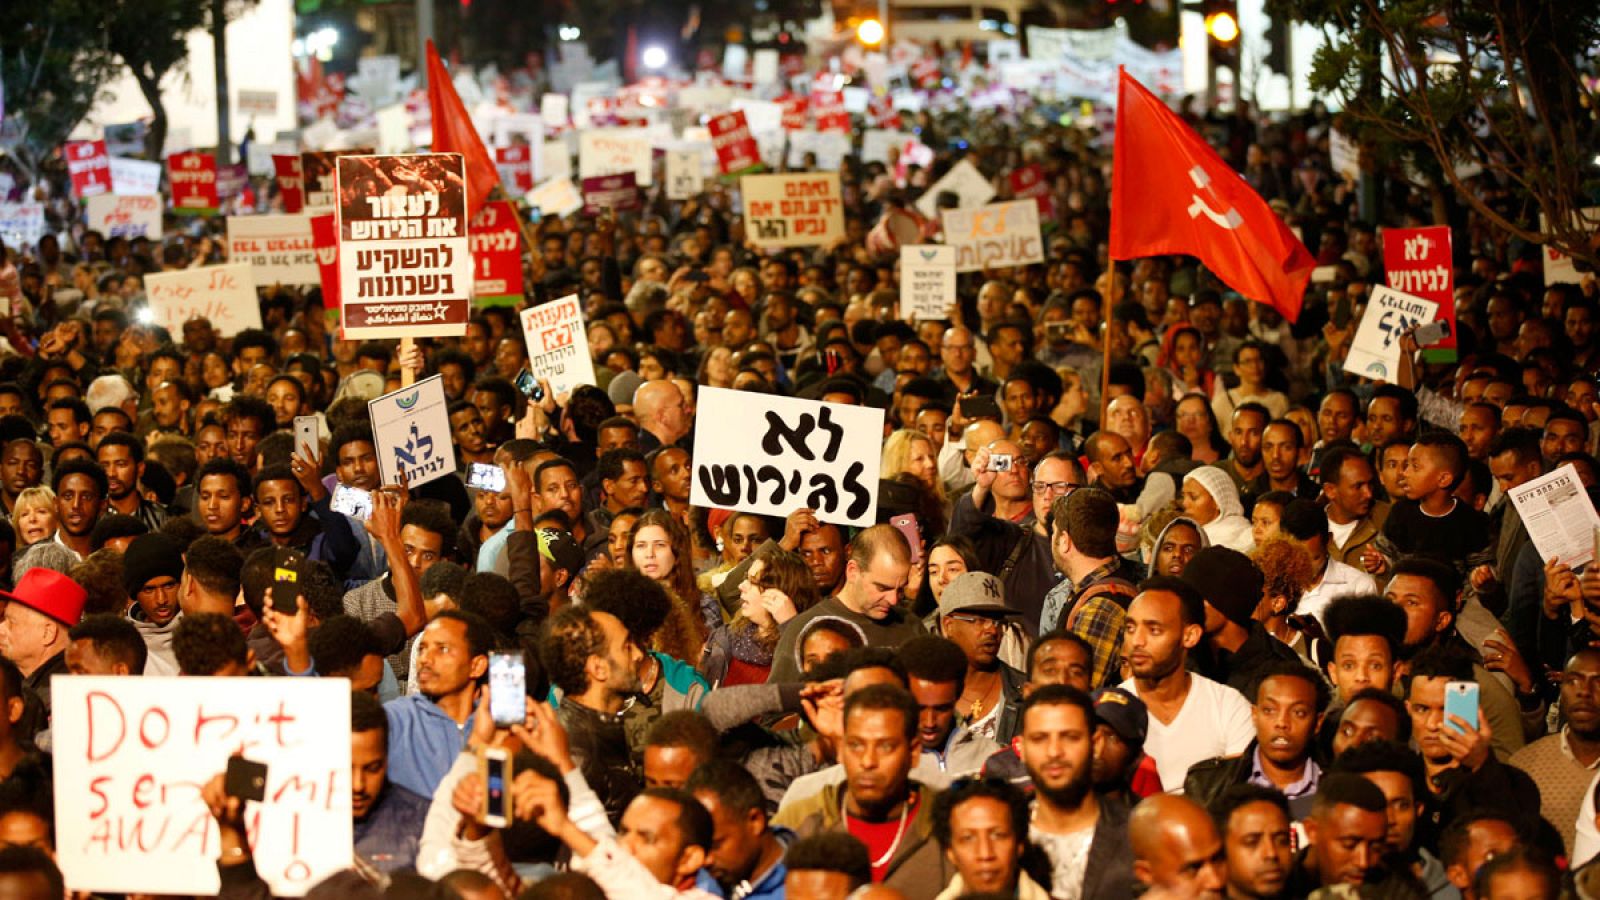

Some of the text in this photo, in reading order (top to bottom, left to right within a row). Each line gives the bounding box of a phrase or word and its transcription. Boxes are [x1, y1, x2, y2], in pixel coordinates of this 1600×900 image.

[785, 180, 829, 198] ואתם
[365, 190, 440, 218] לעצור
[780, 198, 839, 216] ידעתם
[351, 217, 457, 240] את הגירוש
[471, 228, 518, 252] לגירו
[356, 243, 453, 274] להשקיע
[1404, 233, 1430, 261] לא
[357, 273, 454, 298] בשכונות
[1387, 264, 1449, 292] לגירוש
[542, 323, 573, 351] לא
[393, 421, 433, 472] לא
[762, 405, 844, 463] לא
[698, 460, 871, 520] לגירוש
